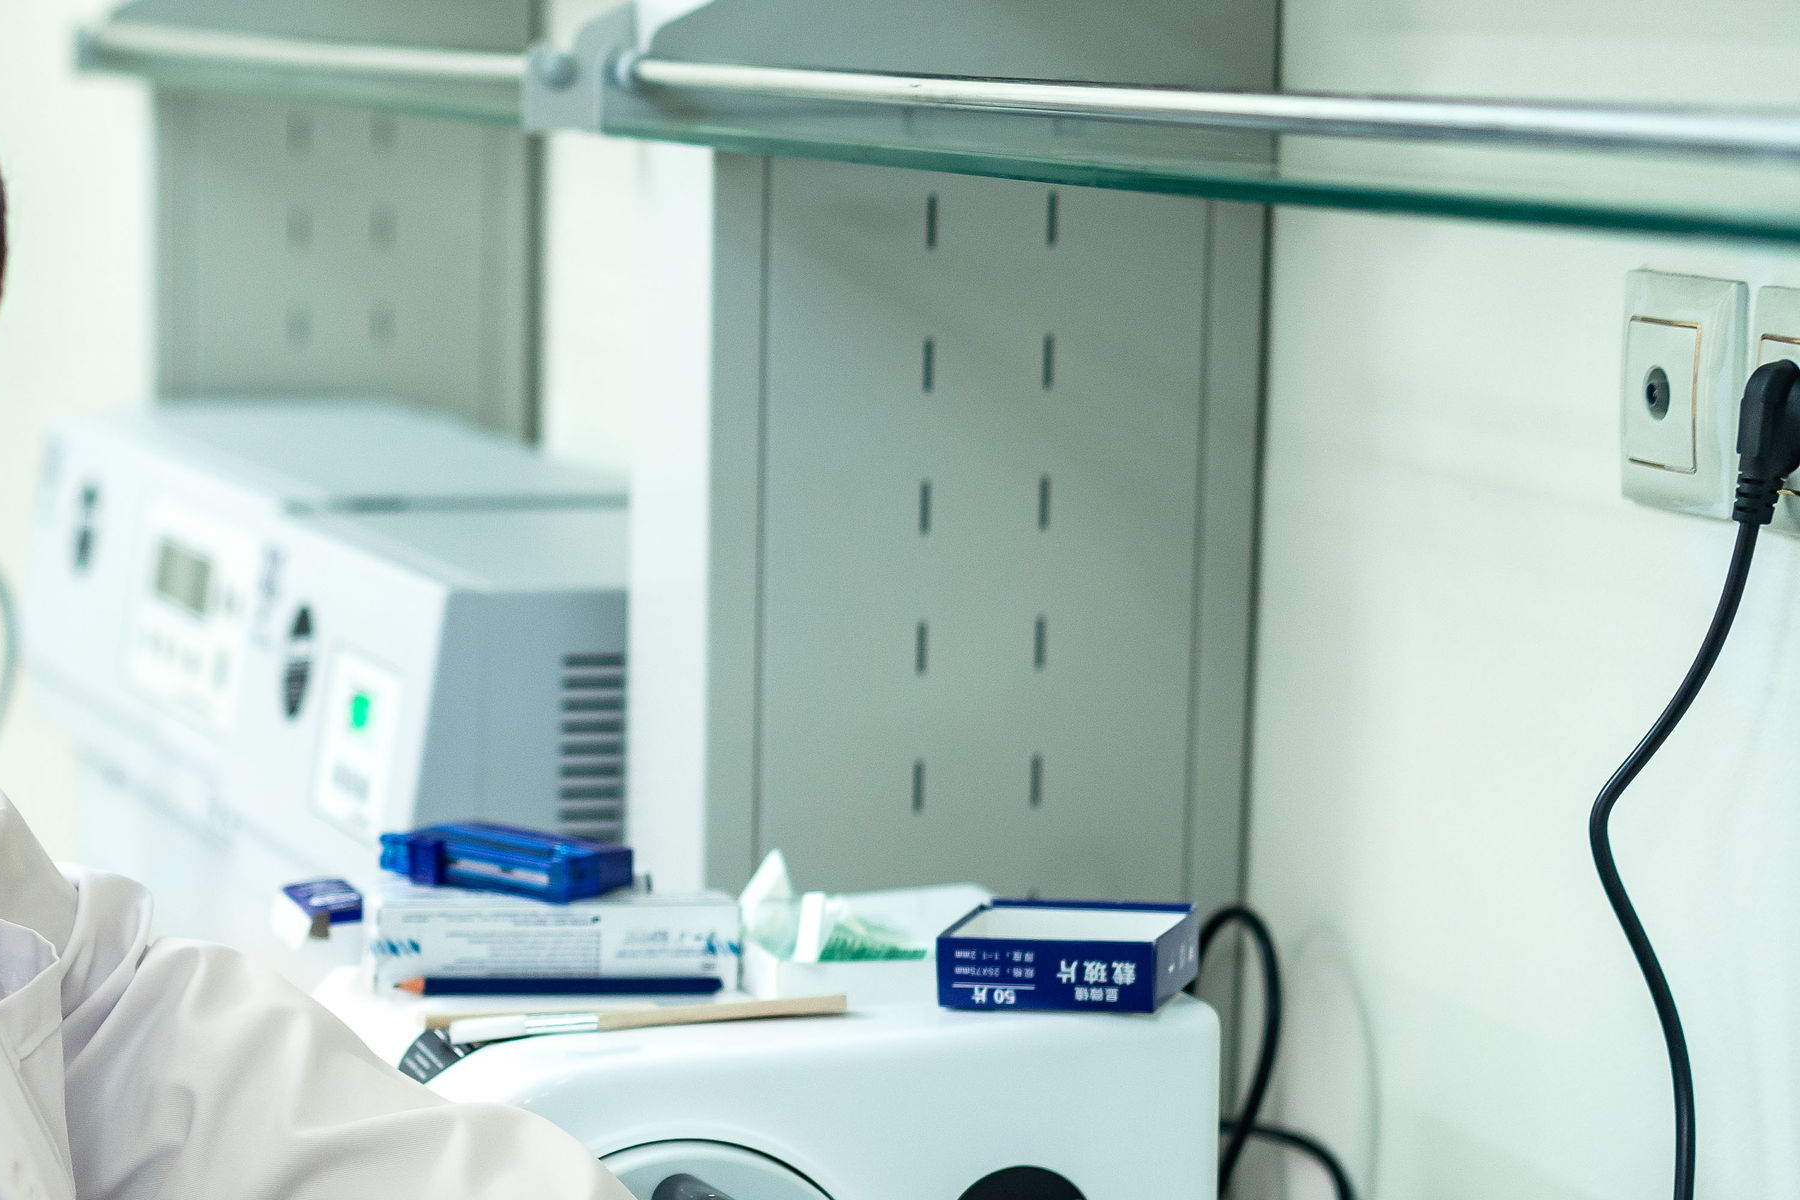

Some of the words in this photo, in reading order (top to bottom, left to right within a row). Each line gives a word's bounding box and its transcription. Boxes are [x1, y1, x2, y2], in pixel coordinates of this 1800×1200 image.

[1056, 959, 1136, 985] 载玻片
[971, 986, 988, 1004] 片
[993, 989, 1016, 1005] 50
[1074, 986, 1119, 1002] 显微镜
